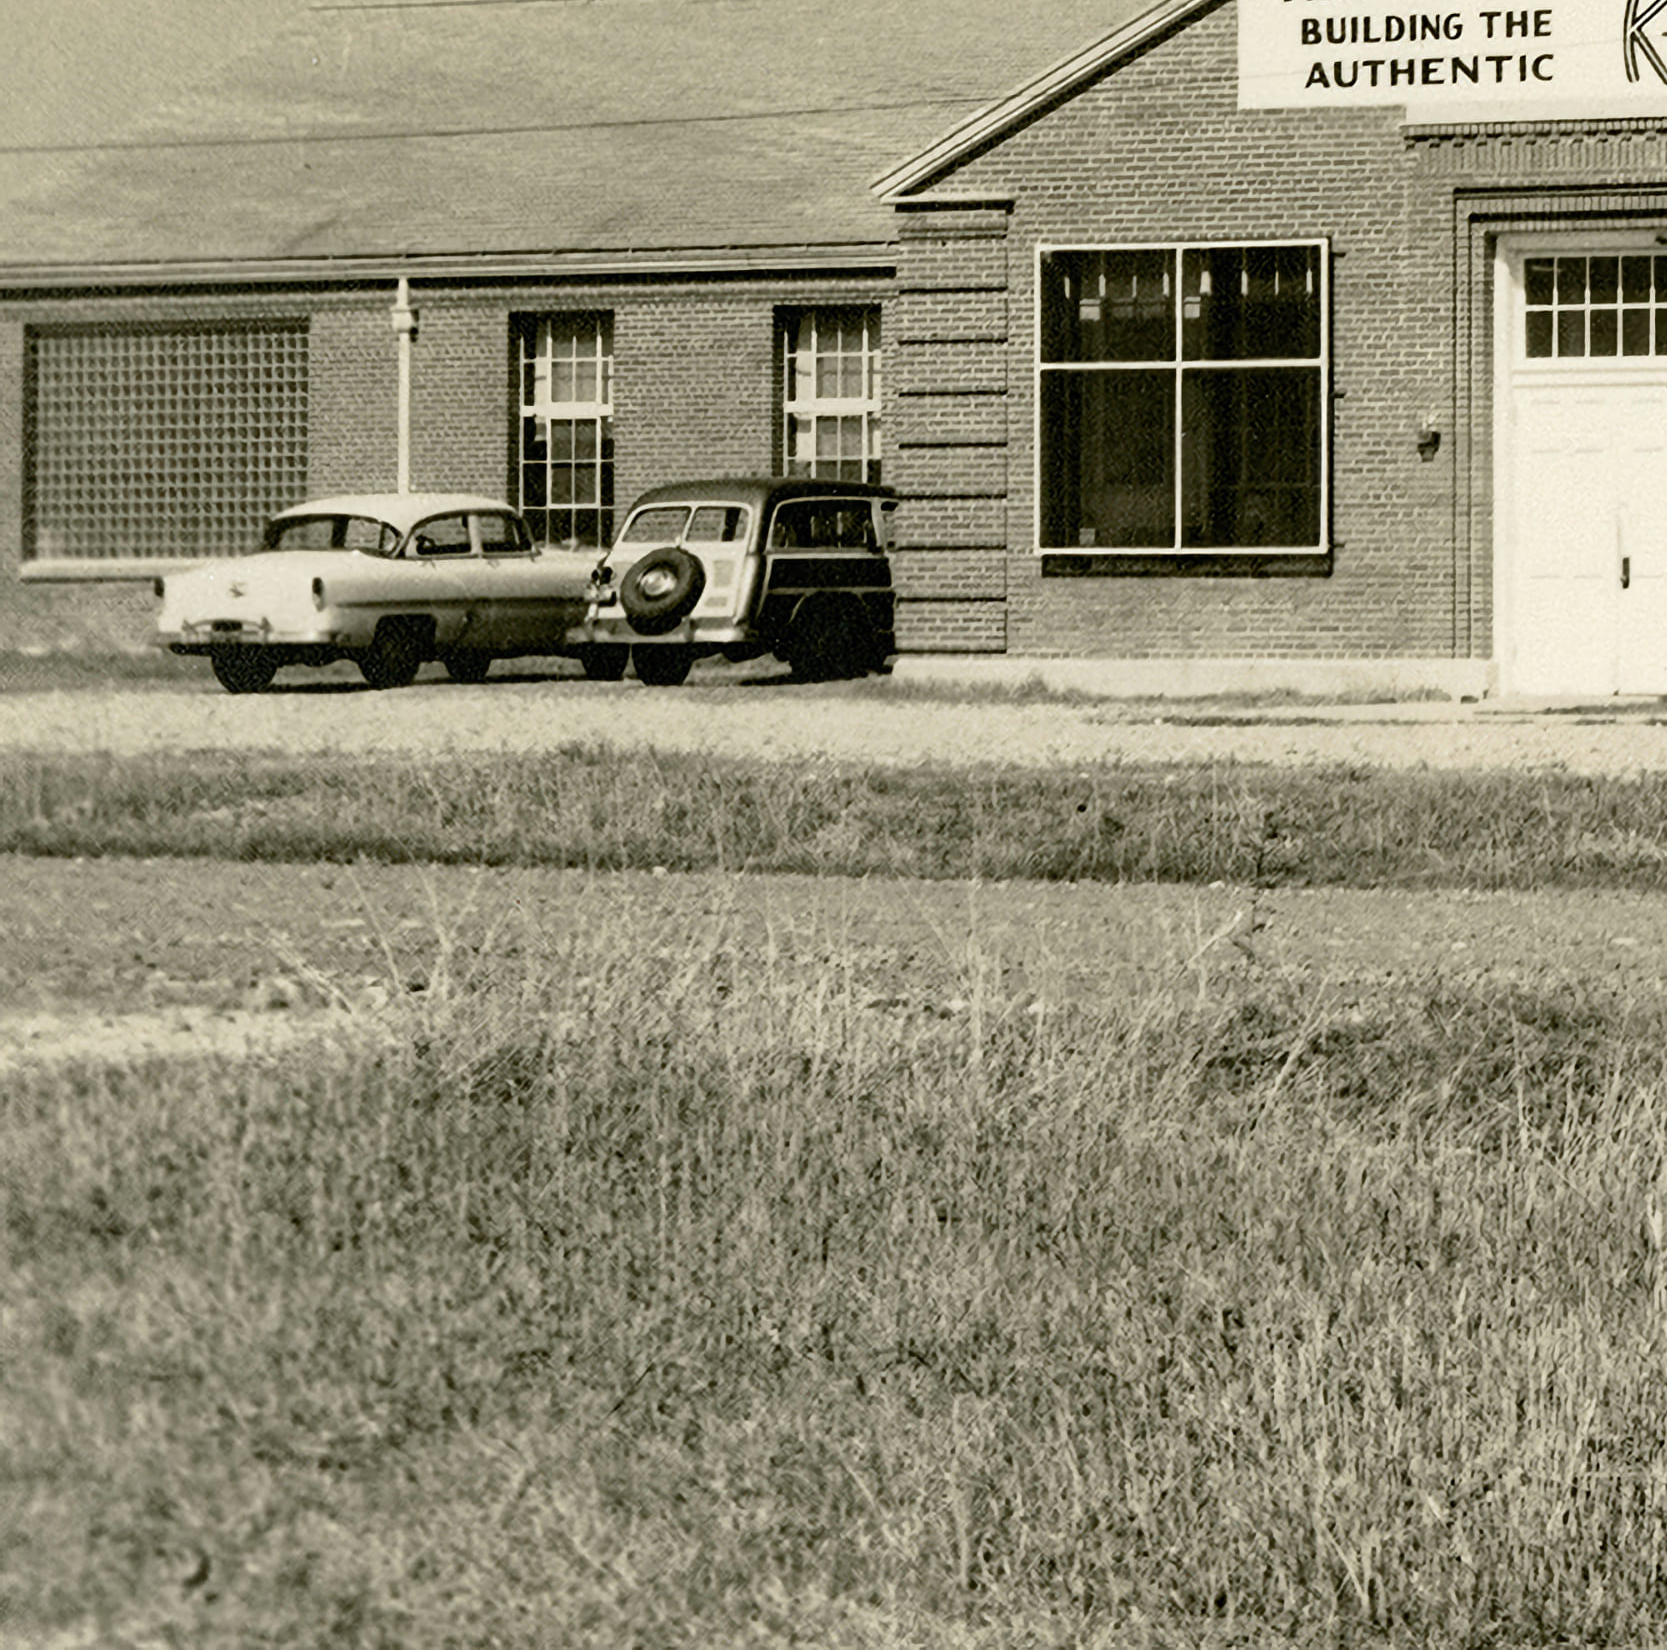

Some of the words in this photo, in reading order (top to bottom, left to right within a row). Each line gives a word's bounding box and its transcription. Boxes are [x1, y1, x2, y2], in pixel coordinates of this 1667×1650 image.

[1300, 12, 1465, 46] BUILDING
[1479, 9, 1554, 40] THE
[1304, 53, 1555, 89] AUTHENTIC
